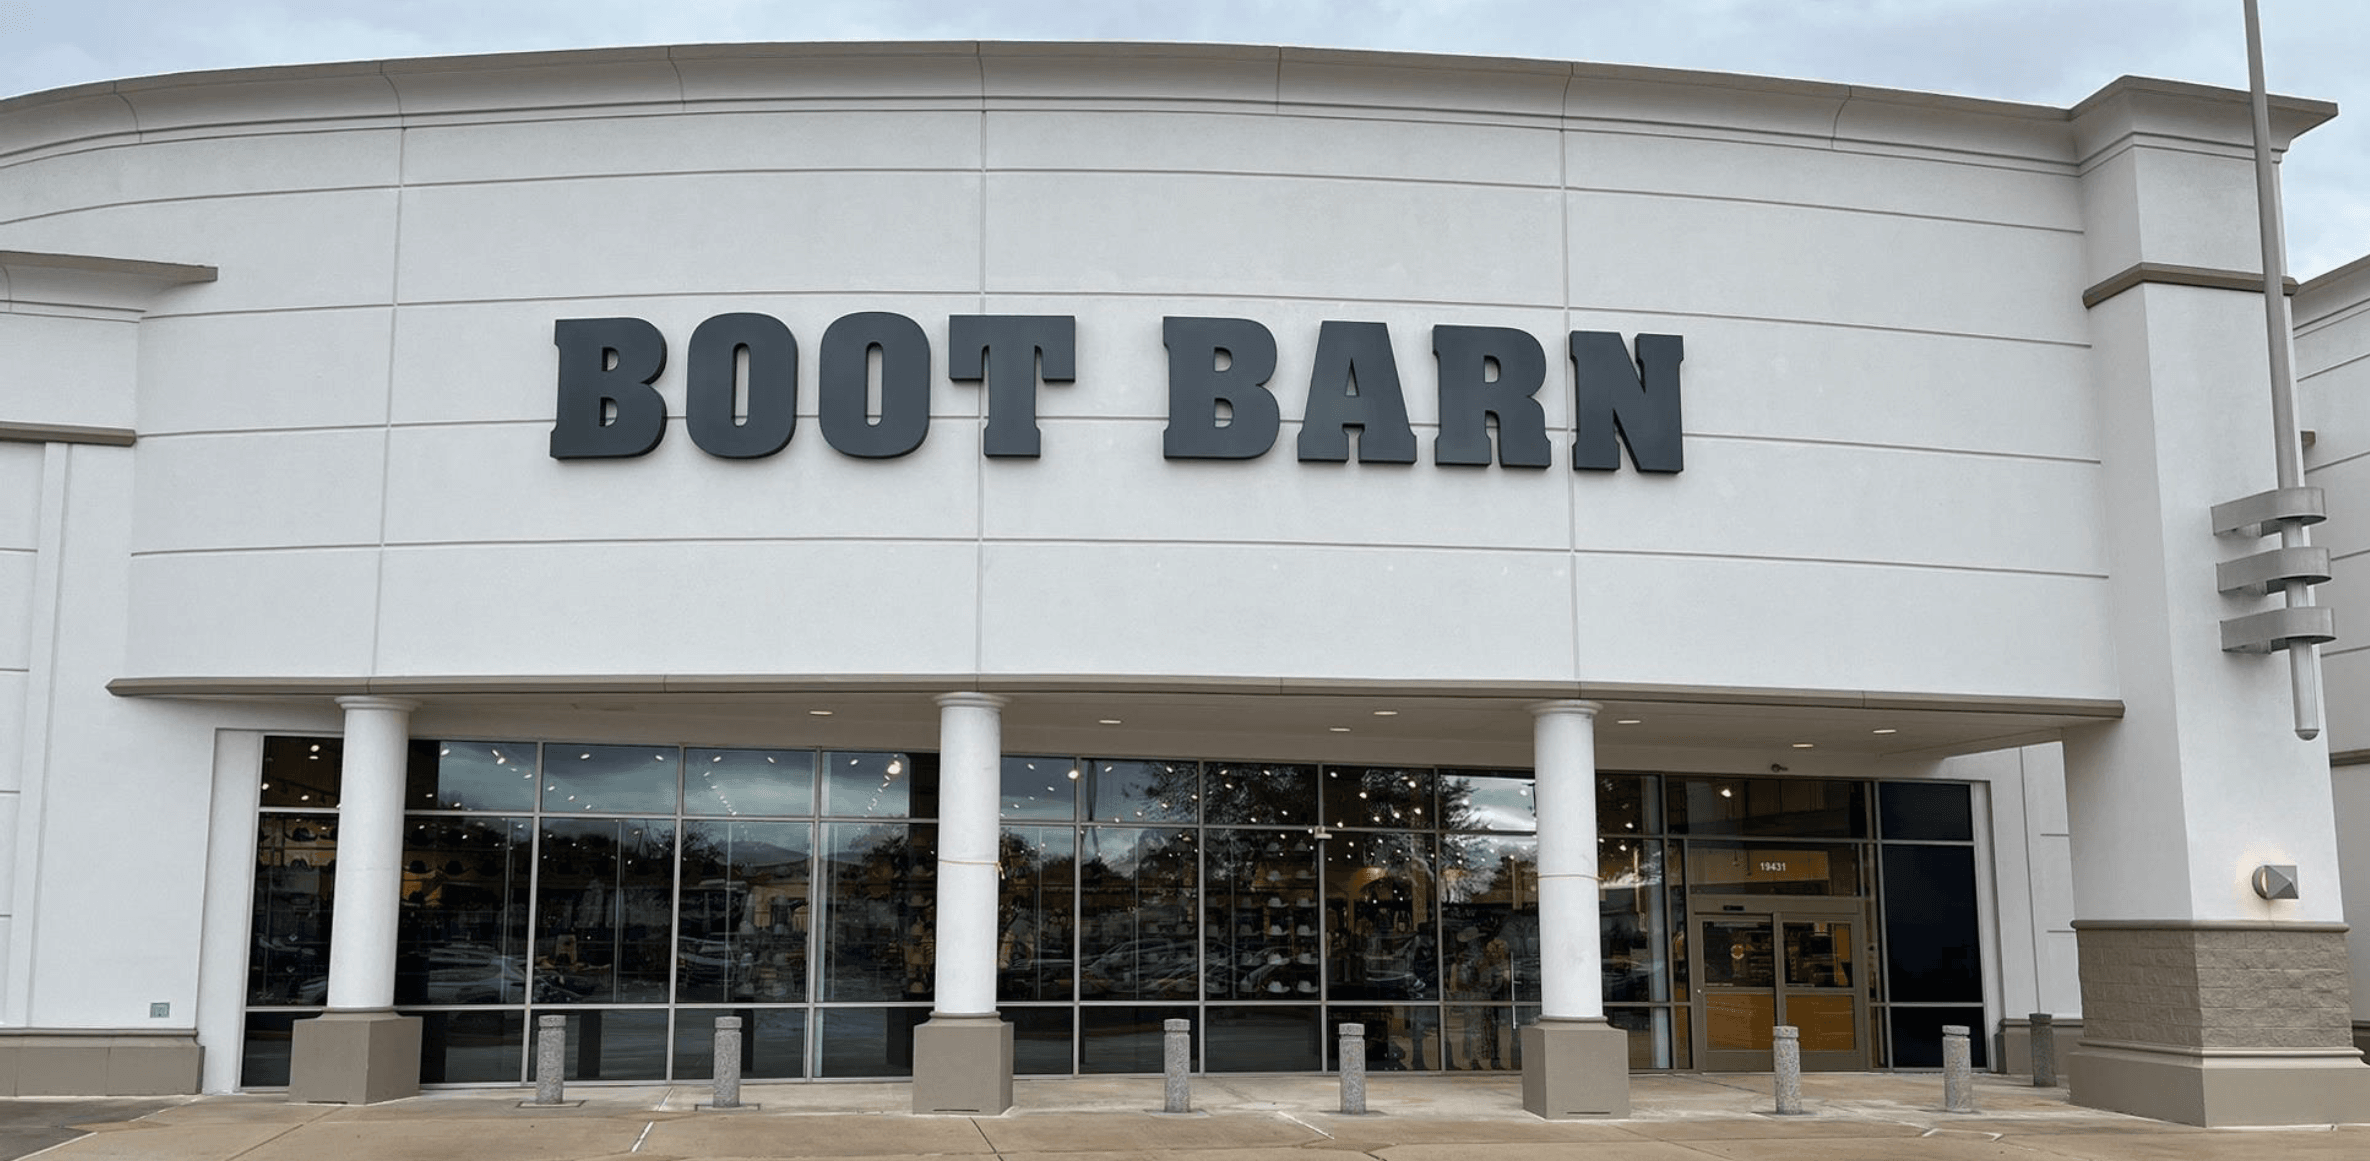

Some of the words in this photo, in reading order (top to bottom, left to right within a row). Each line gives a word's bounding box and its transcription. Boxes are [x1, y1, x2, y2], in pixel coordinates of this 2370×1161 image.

[550, 312, 1076, 460] BOOT
[1163, 317, 1684, 474] BARN
[1760, 861, 1786, 871] 19431
